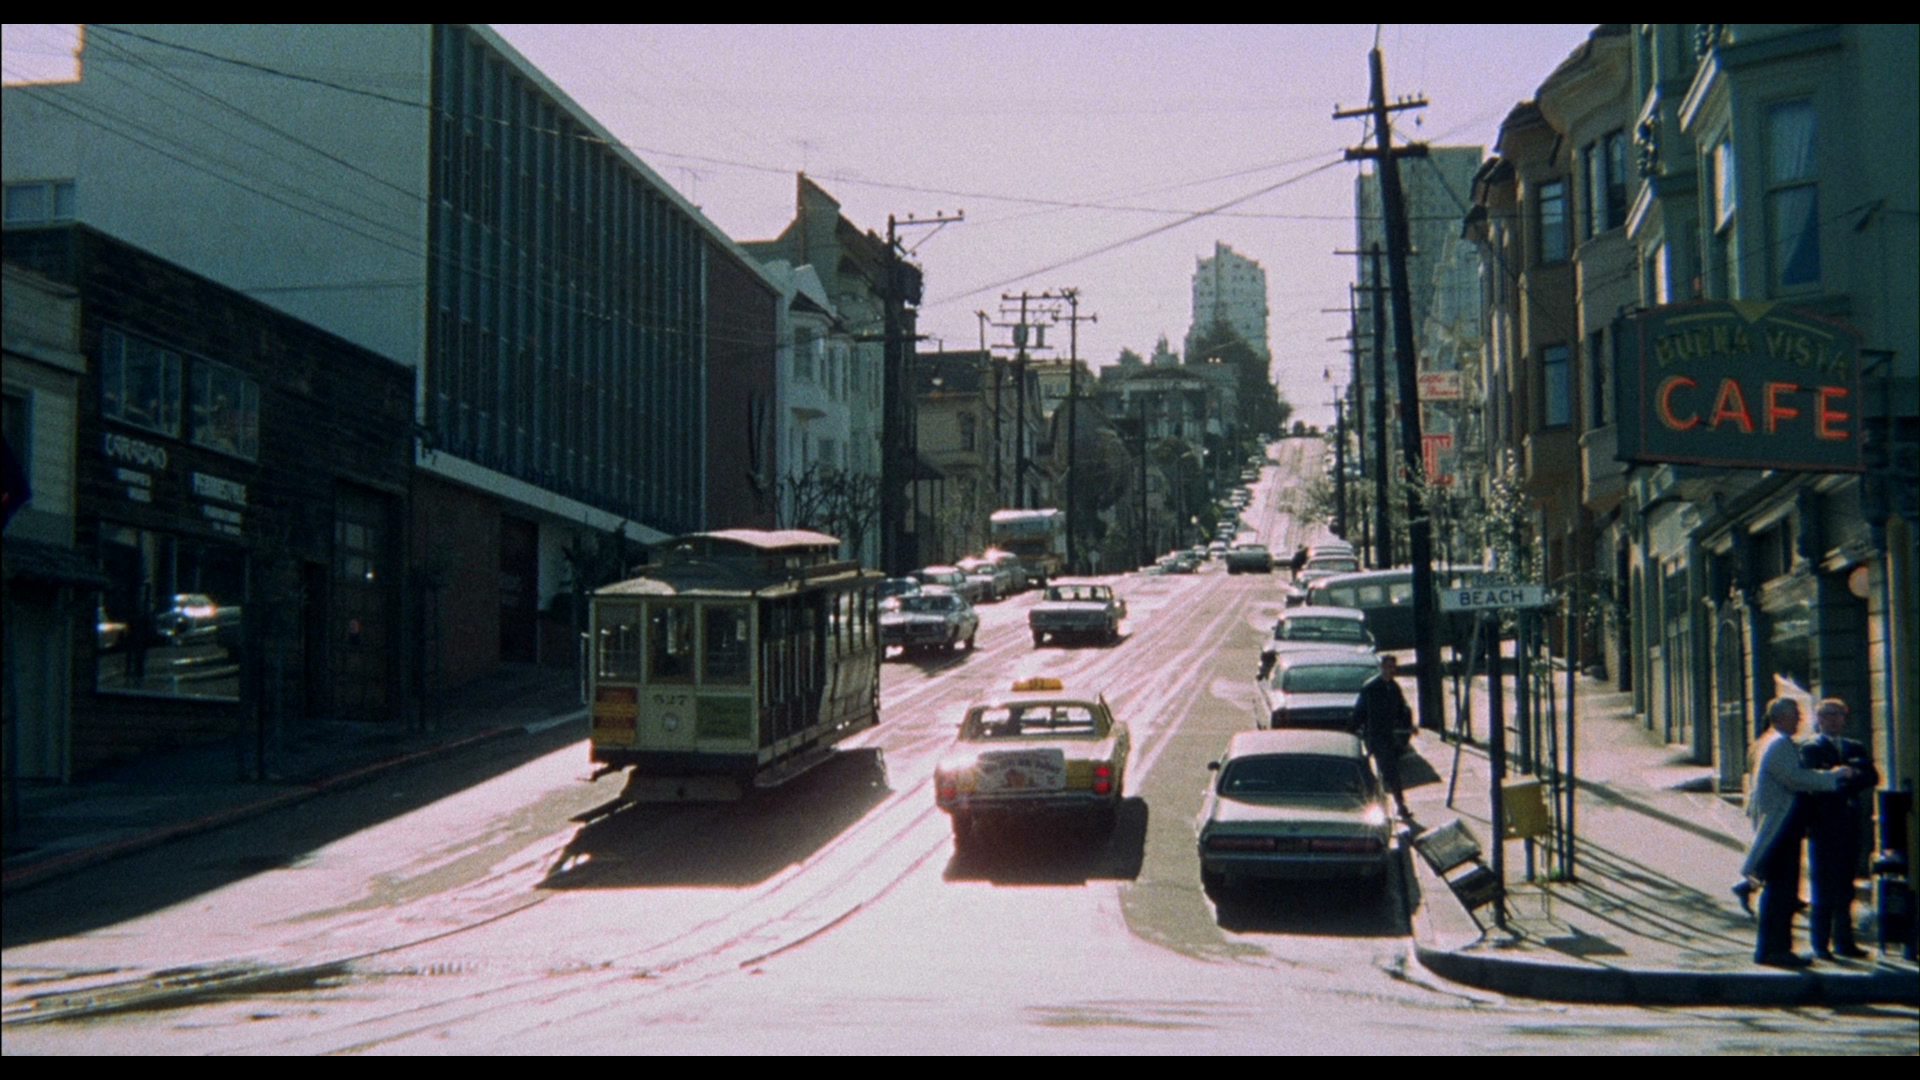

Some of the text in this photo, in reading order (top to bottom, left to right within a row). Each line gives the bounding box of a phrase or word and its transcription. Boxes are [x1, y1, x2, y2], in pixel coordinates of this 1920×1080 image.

[1654, 325, 1851, 381] BUENA VISTA
[1655, 375, 1852, 441] CAFE
[1458, 589, 1524, 606] BEACH
